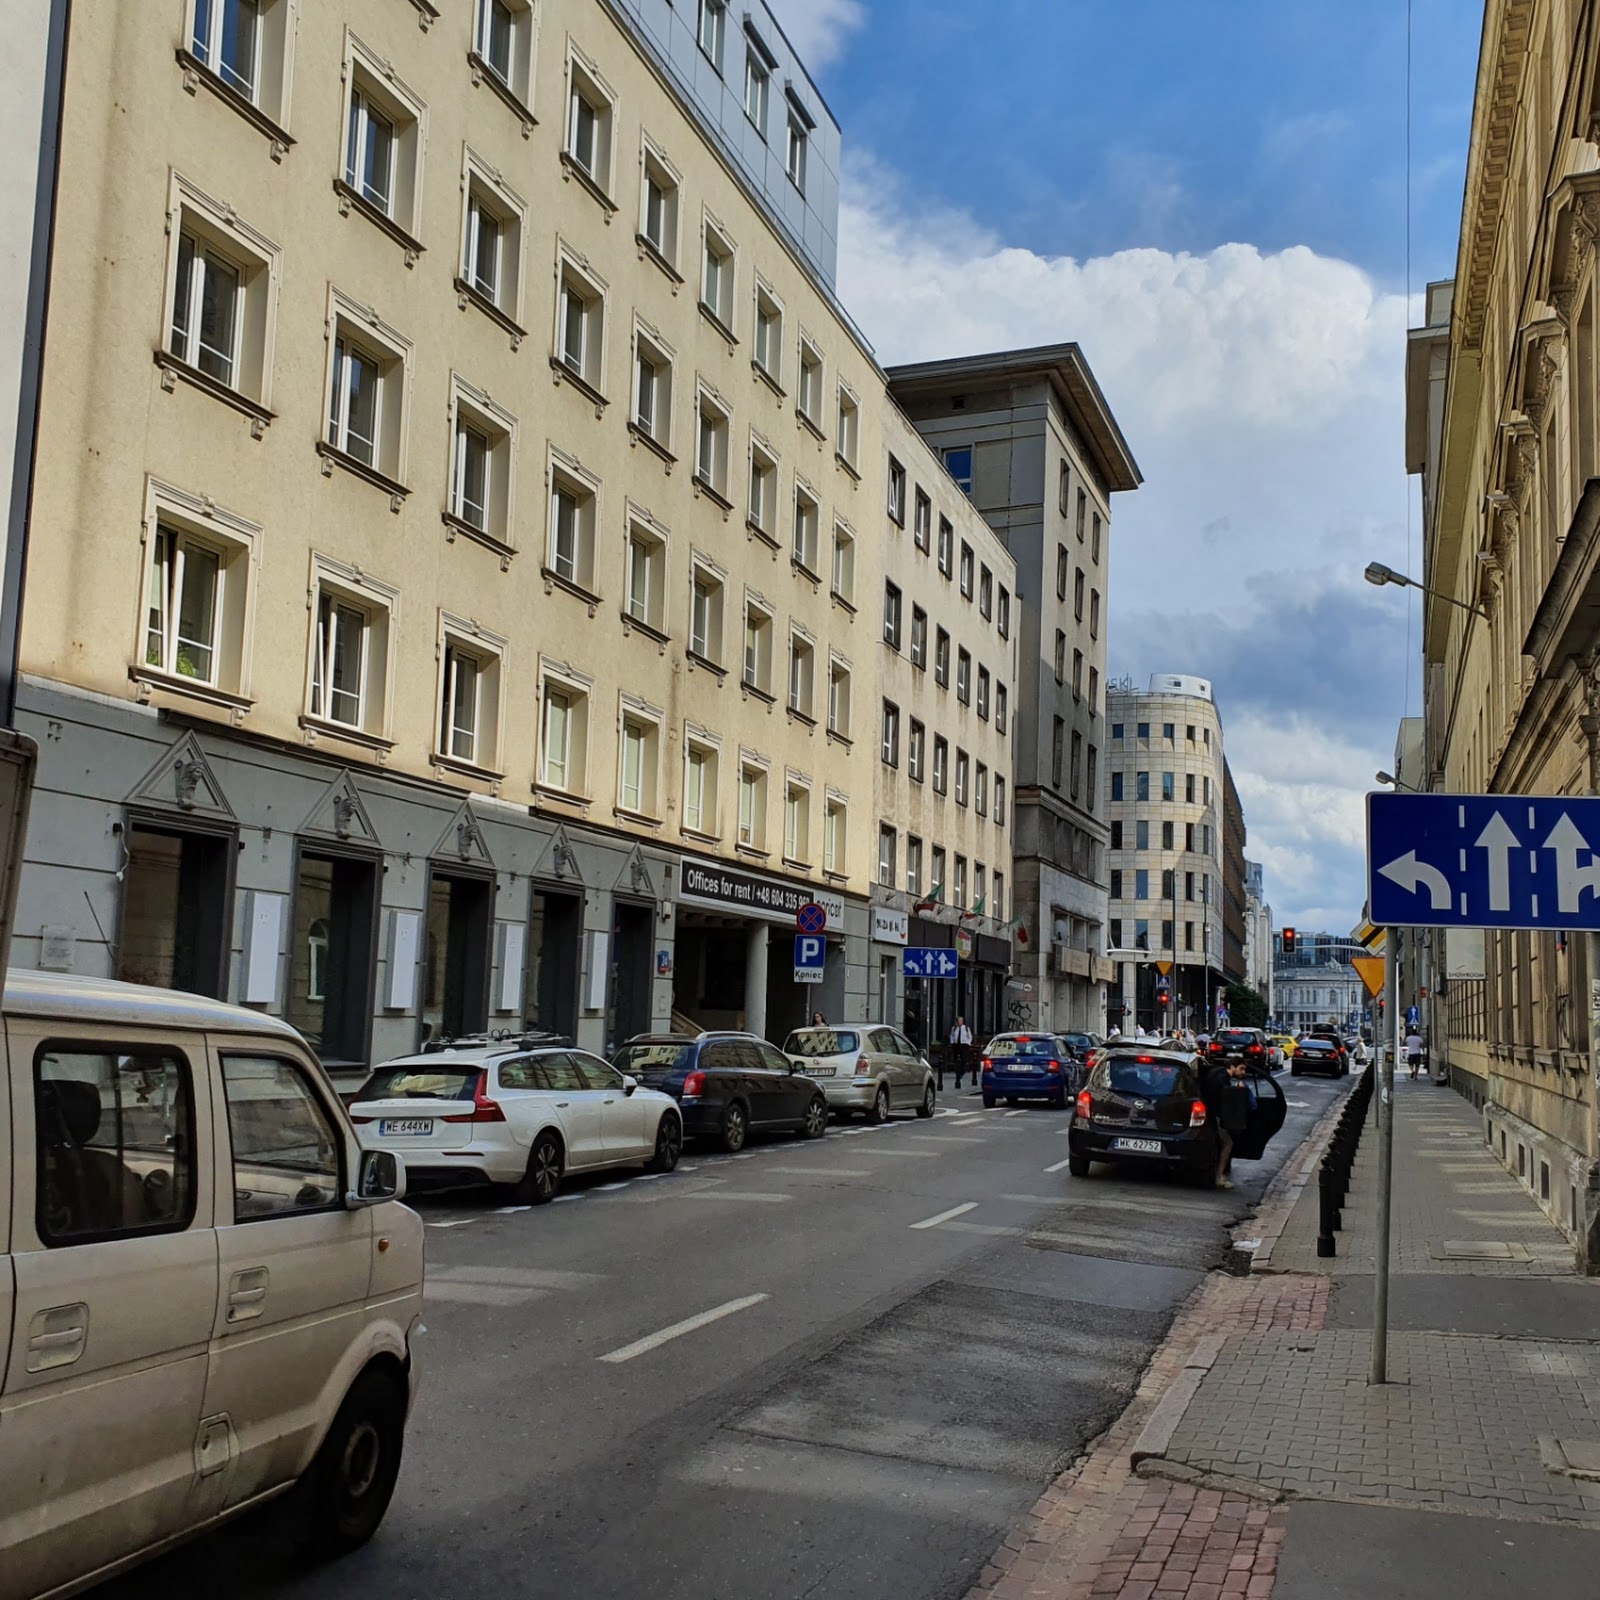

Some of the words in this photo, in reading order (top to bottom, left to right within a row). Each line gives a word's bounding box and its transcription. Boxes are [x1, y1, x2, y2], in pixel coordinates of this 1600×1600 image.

[687, 869, 719, 894] Offices
[720, 876, 733, 896] for
[734, 883, 751, 900] rent
[756, 886, 770, 904] +48
[771, 889, 784, 906] 604
[785, 892, 797, 909] 335
[801, 938, 819, 963] P
[795, 970, 821, 979] Koniec
[386, 1121, 399, 1132] WE
[401, 1121, 430, 1132] 644XW
[1120, 1139, 1131, 1148] WK
[1133, 1141, 1160, 1151] 62752
